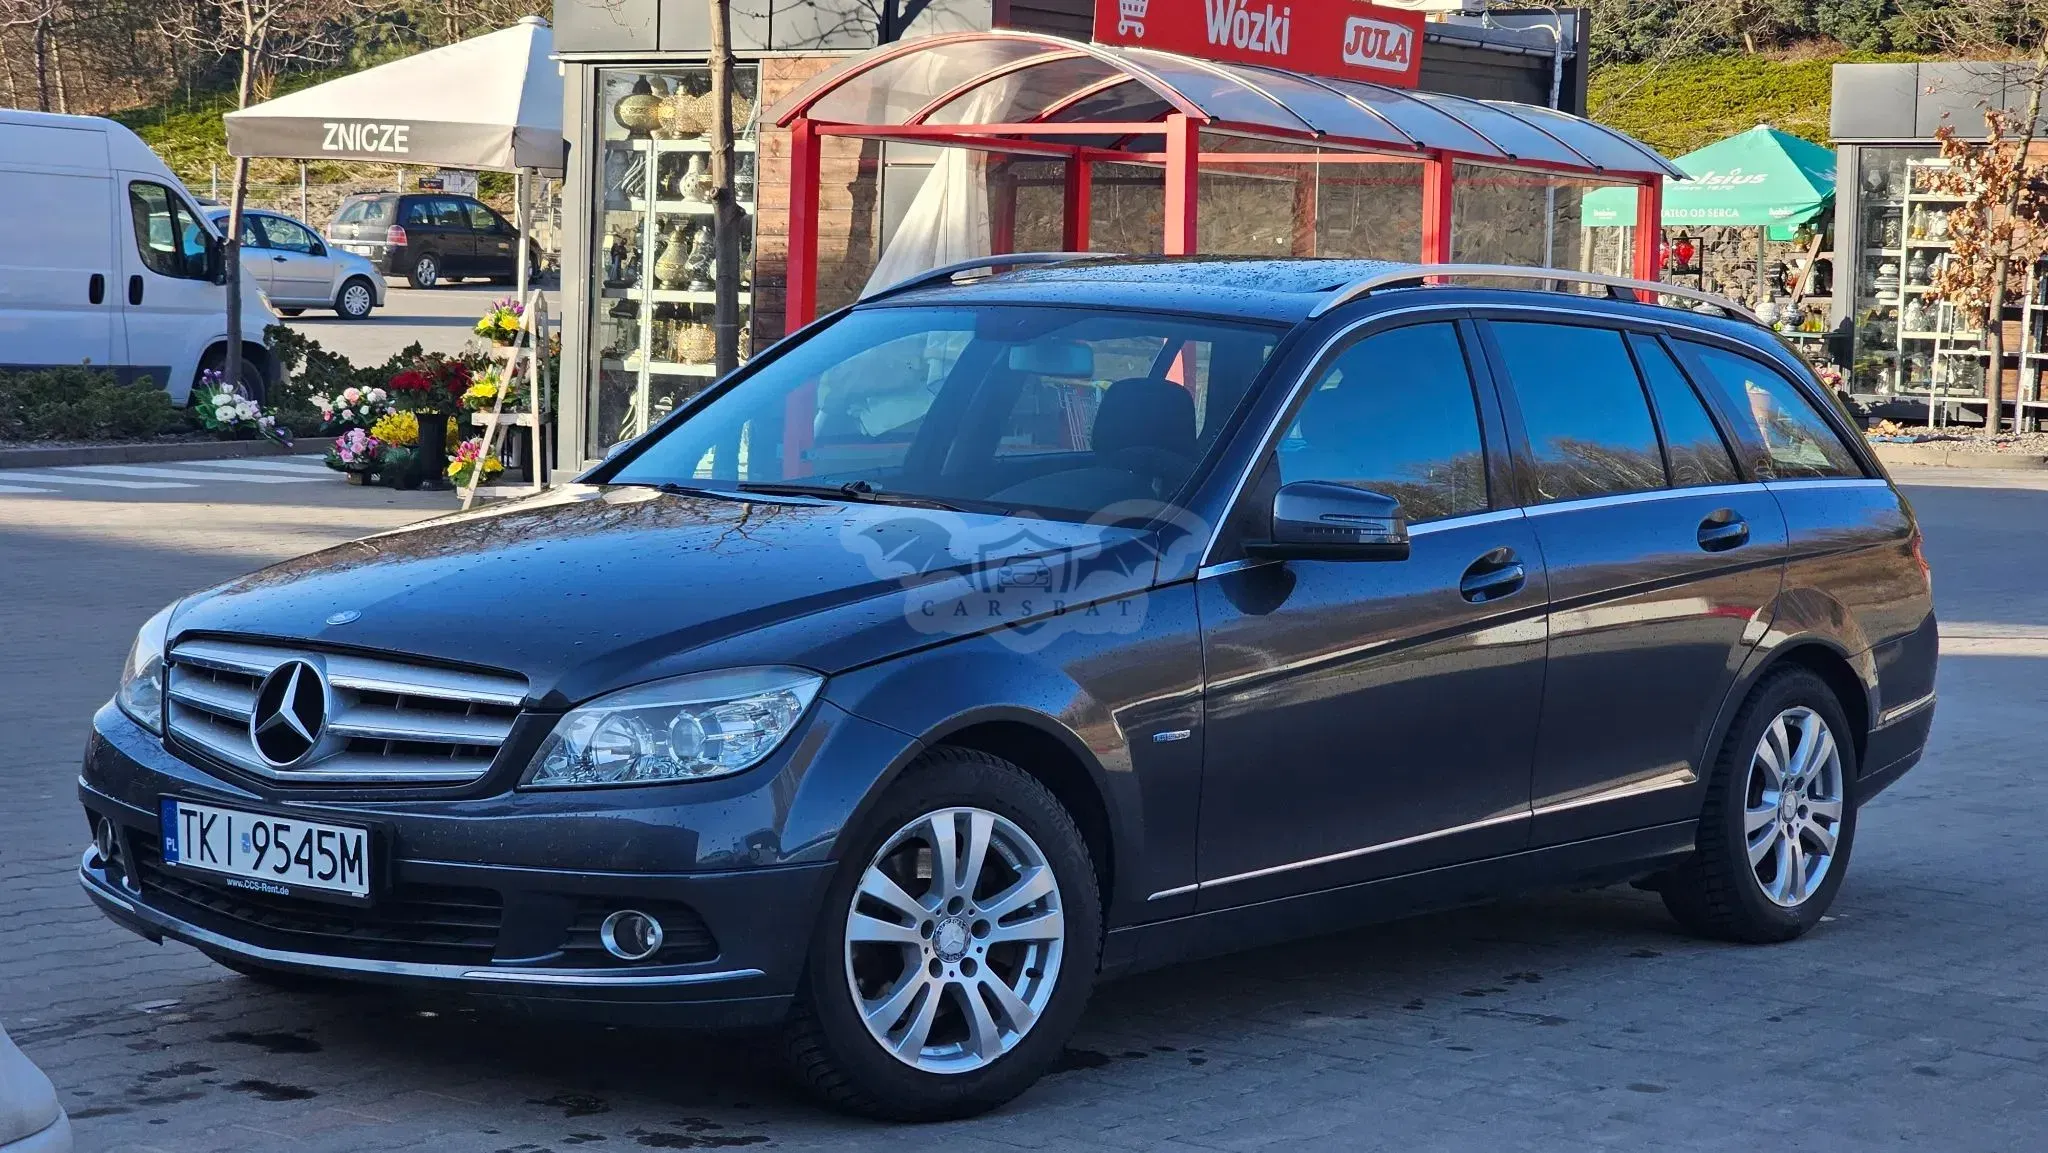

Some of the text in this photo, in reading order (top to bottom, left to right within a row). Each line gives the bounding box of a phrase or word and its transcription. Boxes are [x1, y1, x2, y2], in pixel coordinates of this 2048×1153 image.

[1205, 0, 1290, 55] Wózki
[1345, 25, 1408, 64] JULA
[322, 123, 410, 153] ZNICZE
[1690, 208, 1705, 217] OD
[1707, 208, 1739, 217] SERCA
[166, 837, 177, 851] PL
[180, 808, 364, 886] TKI 9545M
[226, 878, 290, 896] www.CCS-Rent.de
